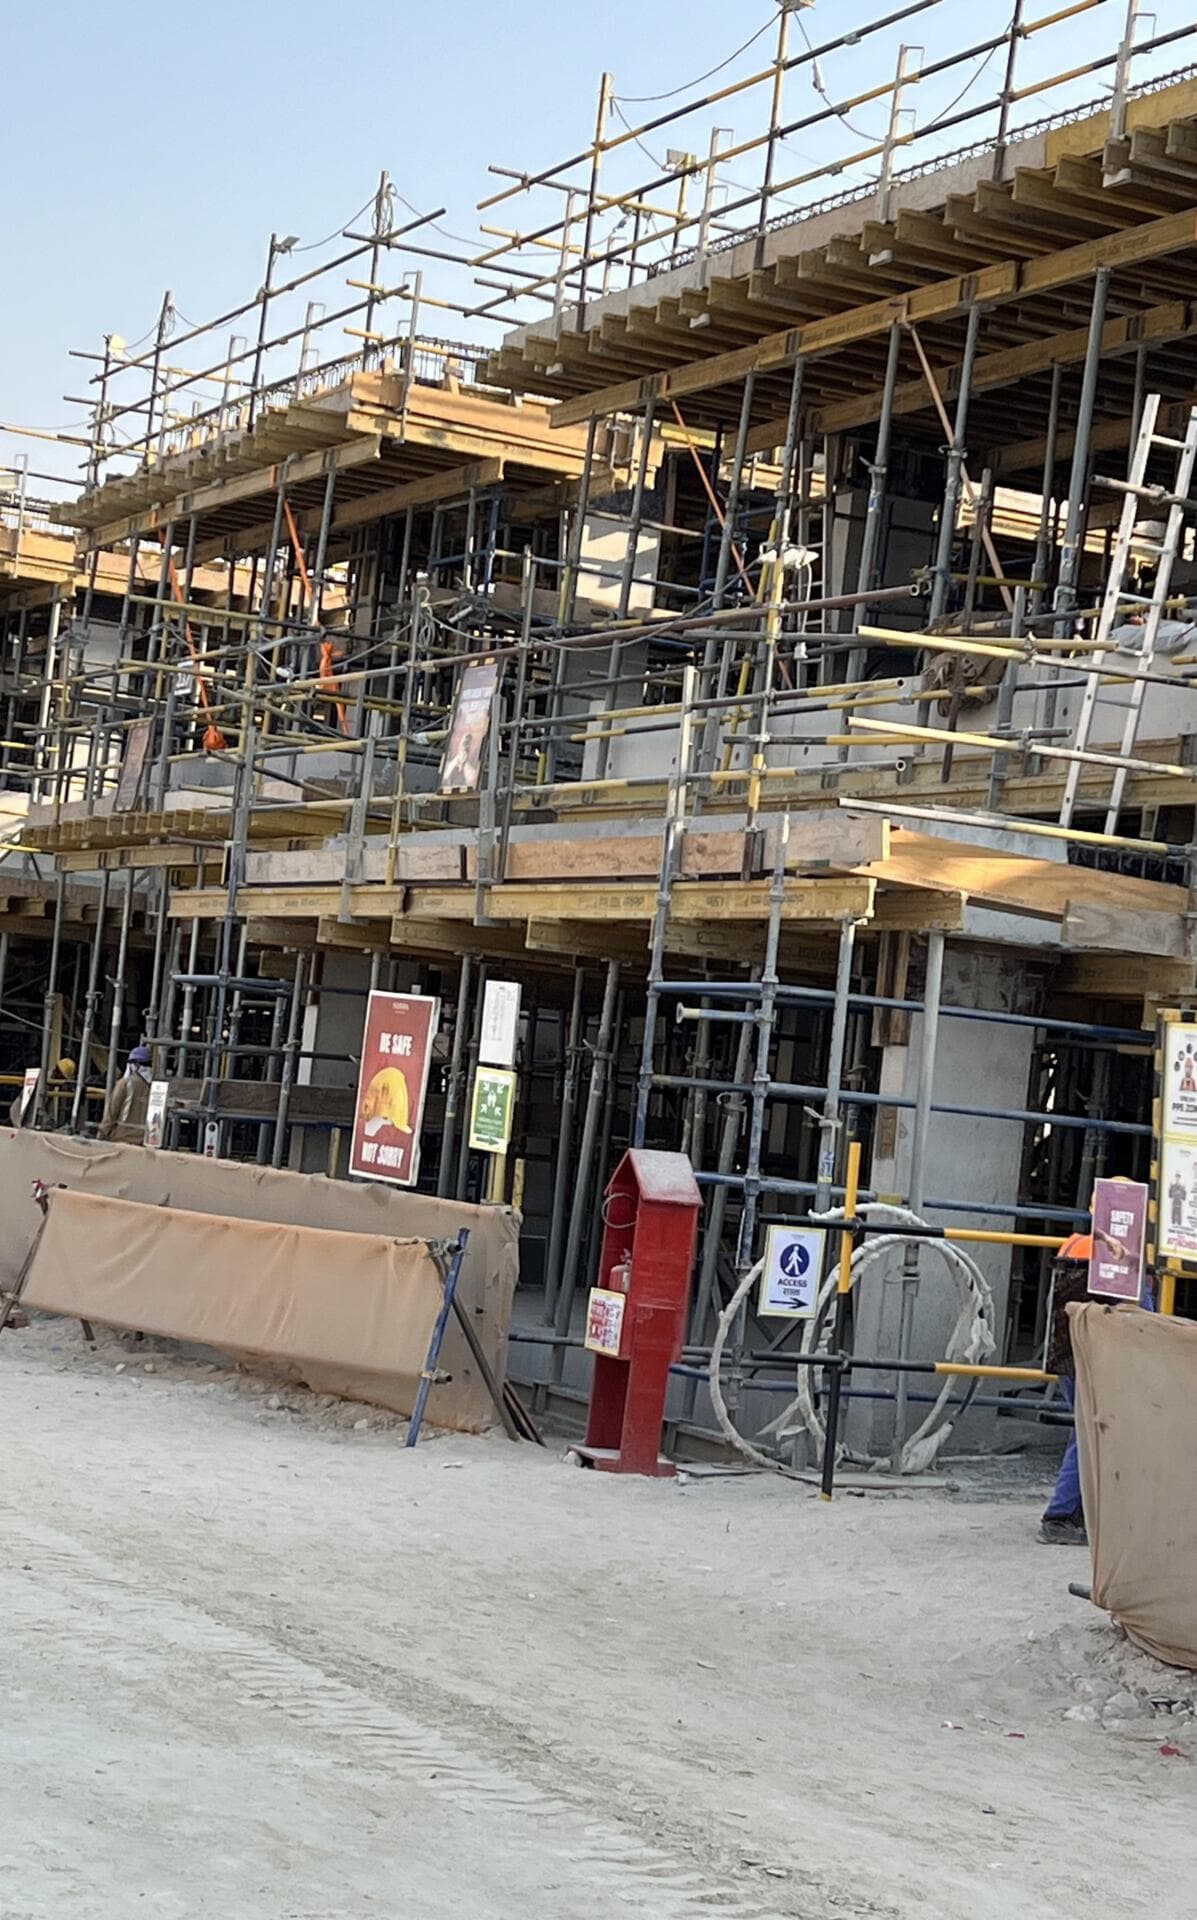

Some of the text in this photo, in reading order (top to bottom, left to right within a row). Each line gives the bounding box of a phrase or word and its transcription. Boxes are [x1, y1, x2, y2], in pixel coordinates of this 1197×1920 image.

[379, 1032, 413, 1056] BE SAFE
[361, 1141, 404, 1169] NOT SORRY
[777, 1278, 808, 1288] ACCESS
